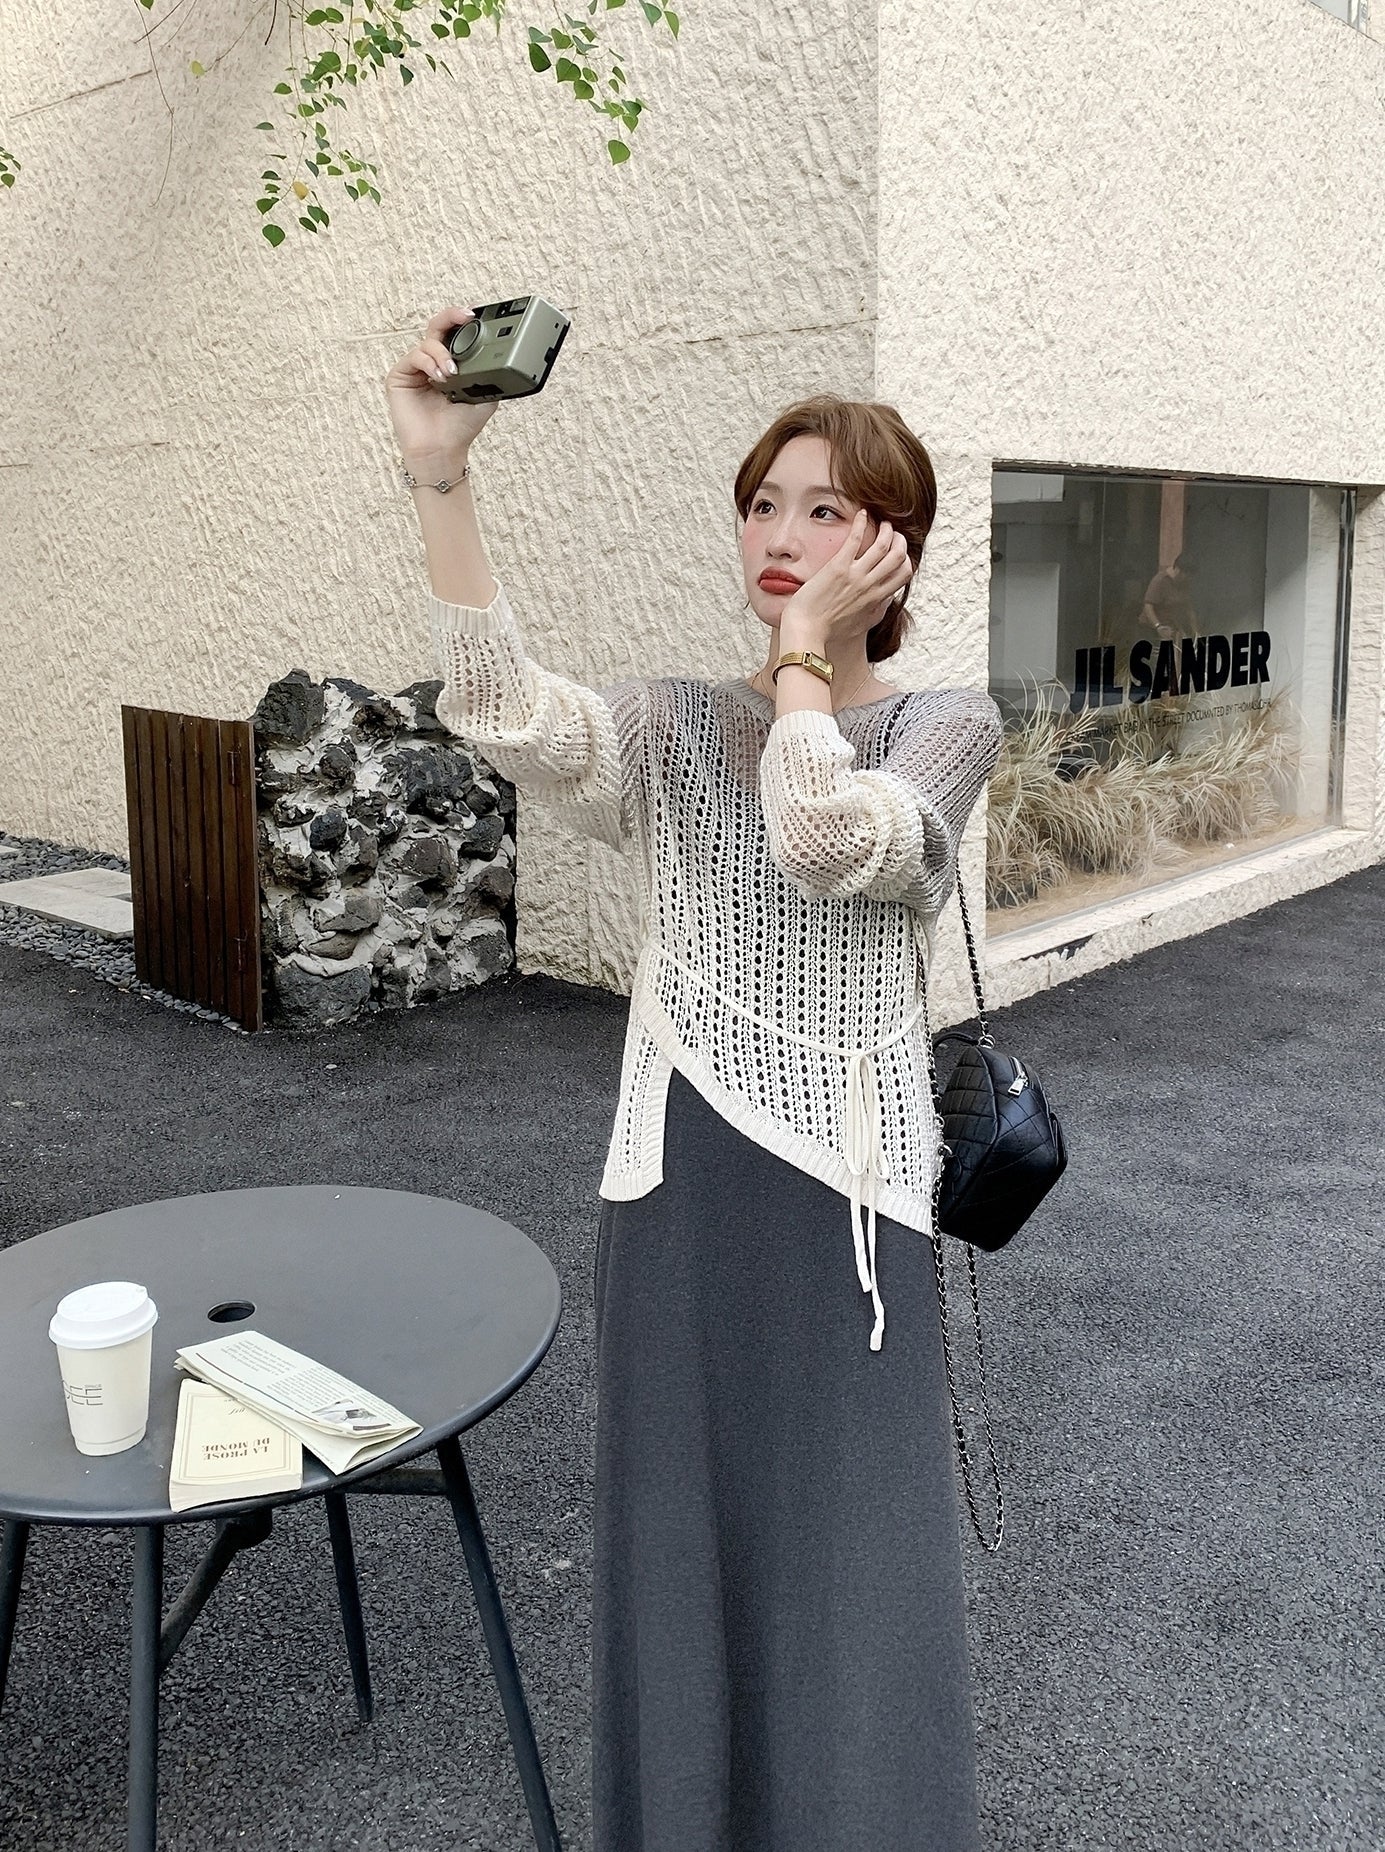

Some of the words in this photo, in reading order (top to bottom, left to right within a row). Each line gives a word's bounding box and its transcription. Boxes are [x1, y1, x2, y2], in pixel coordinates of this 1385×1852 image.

[1070, 646, 1123, 715] JIL
[1129, 631, 1271, 704] SANDER
[1162, 712, 1184, 728] STREET
[201, 1441, 248, 1452] MONDE
[253, 1437, 270, 1447] DU
[203, 1449, 248, 1461] PROSE
[252, 1446, 269, 1454] LA
